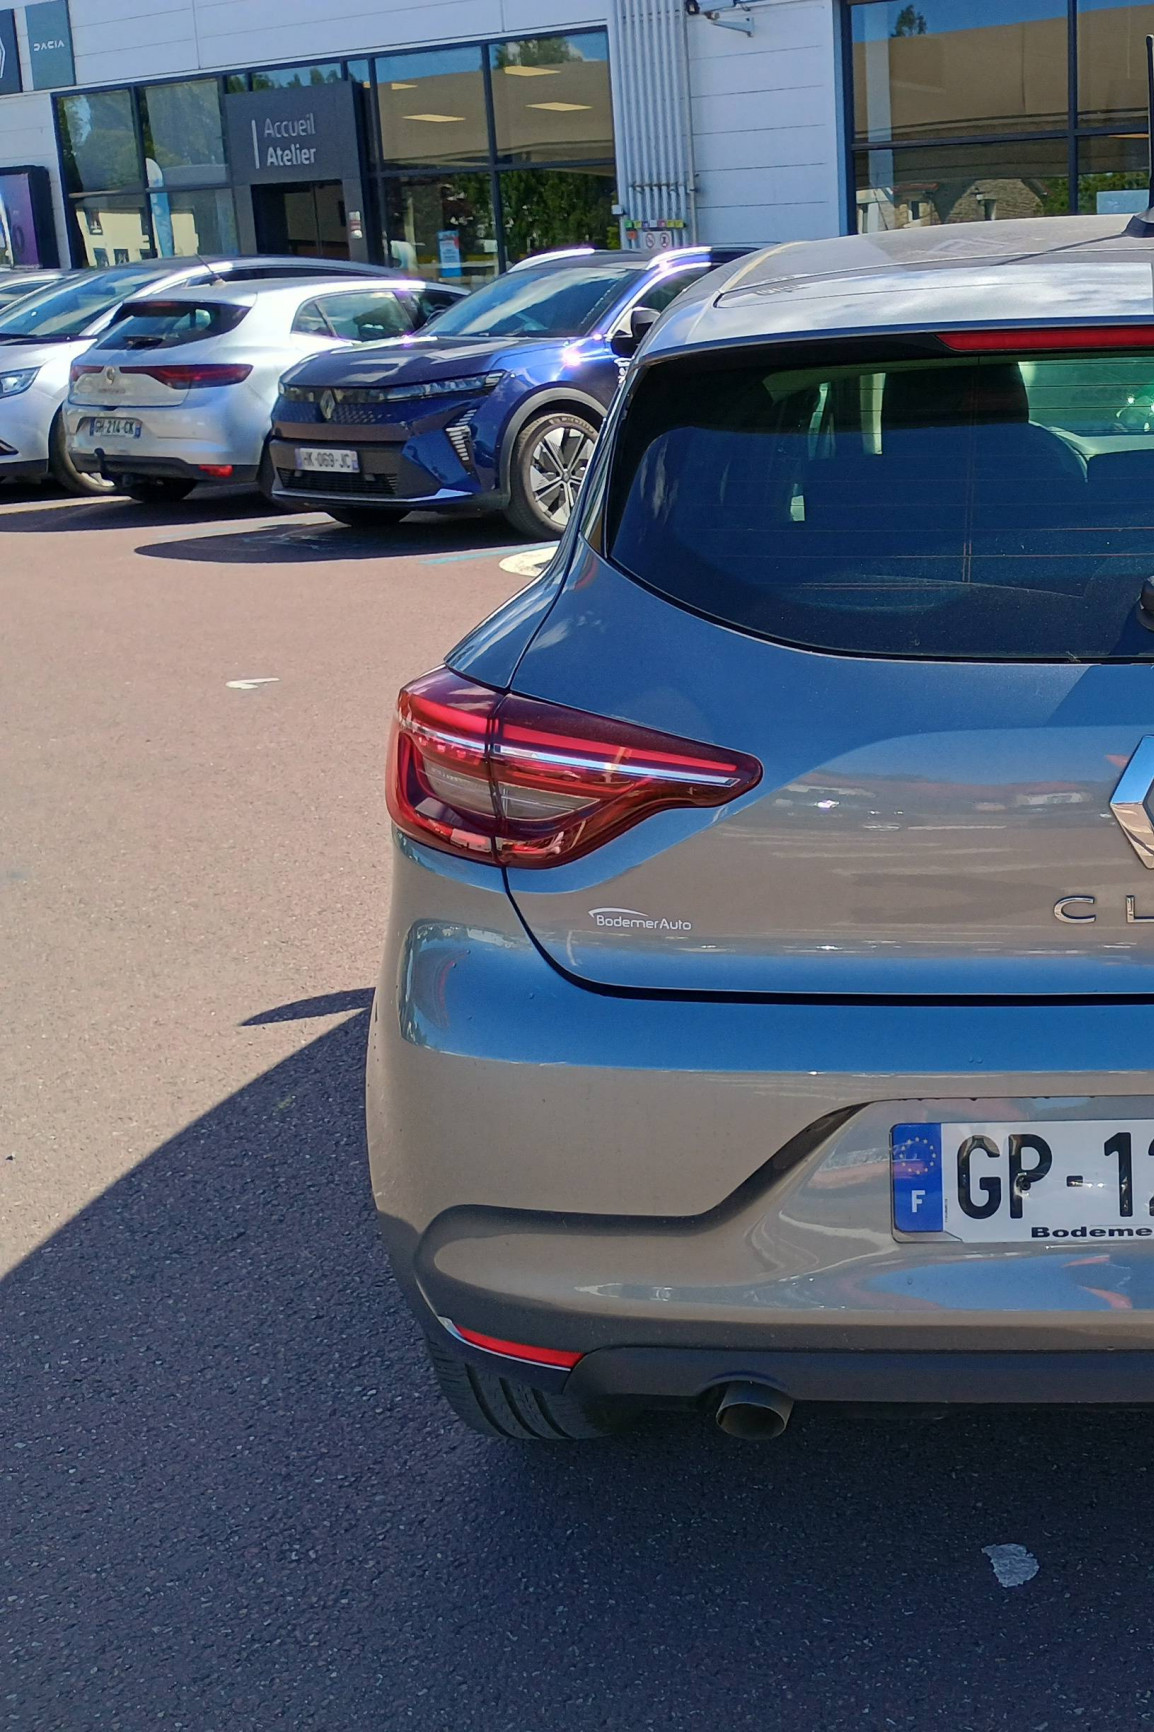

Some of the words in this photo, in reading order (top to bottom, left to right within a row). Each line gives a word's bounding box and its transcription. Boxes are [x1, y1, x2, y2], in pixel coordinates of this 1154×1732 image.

[33, 39, 65, 51] DACIA
[264, 112, 316, 138] Accueil
[266, 143, 317, 167] Atelier
[596, 914, 692, 931] BodemerAuto
[910, 1189, 926, 1213] F
